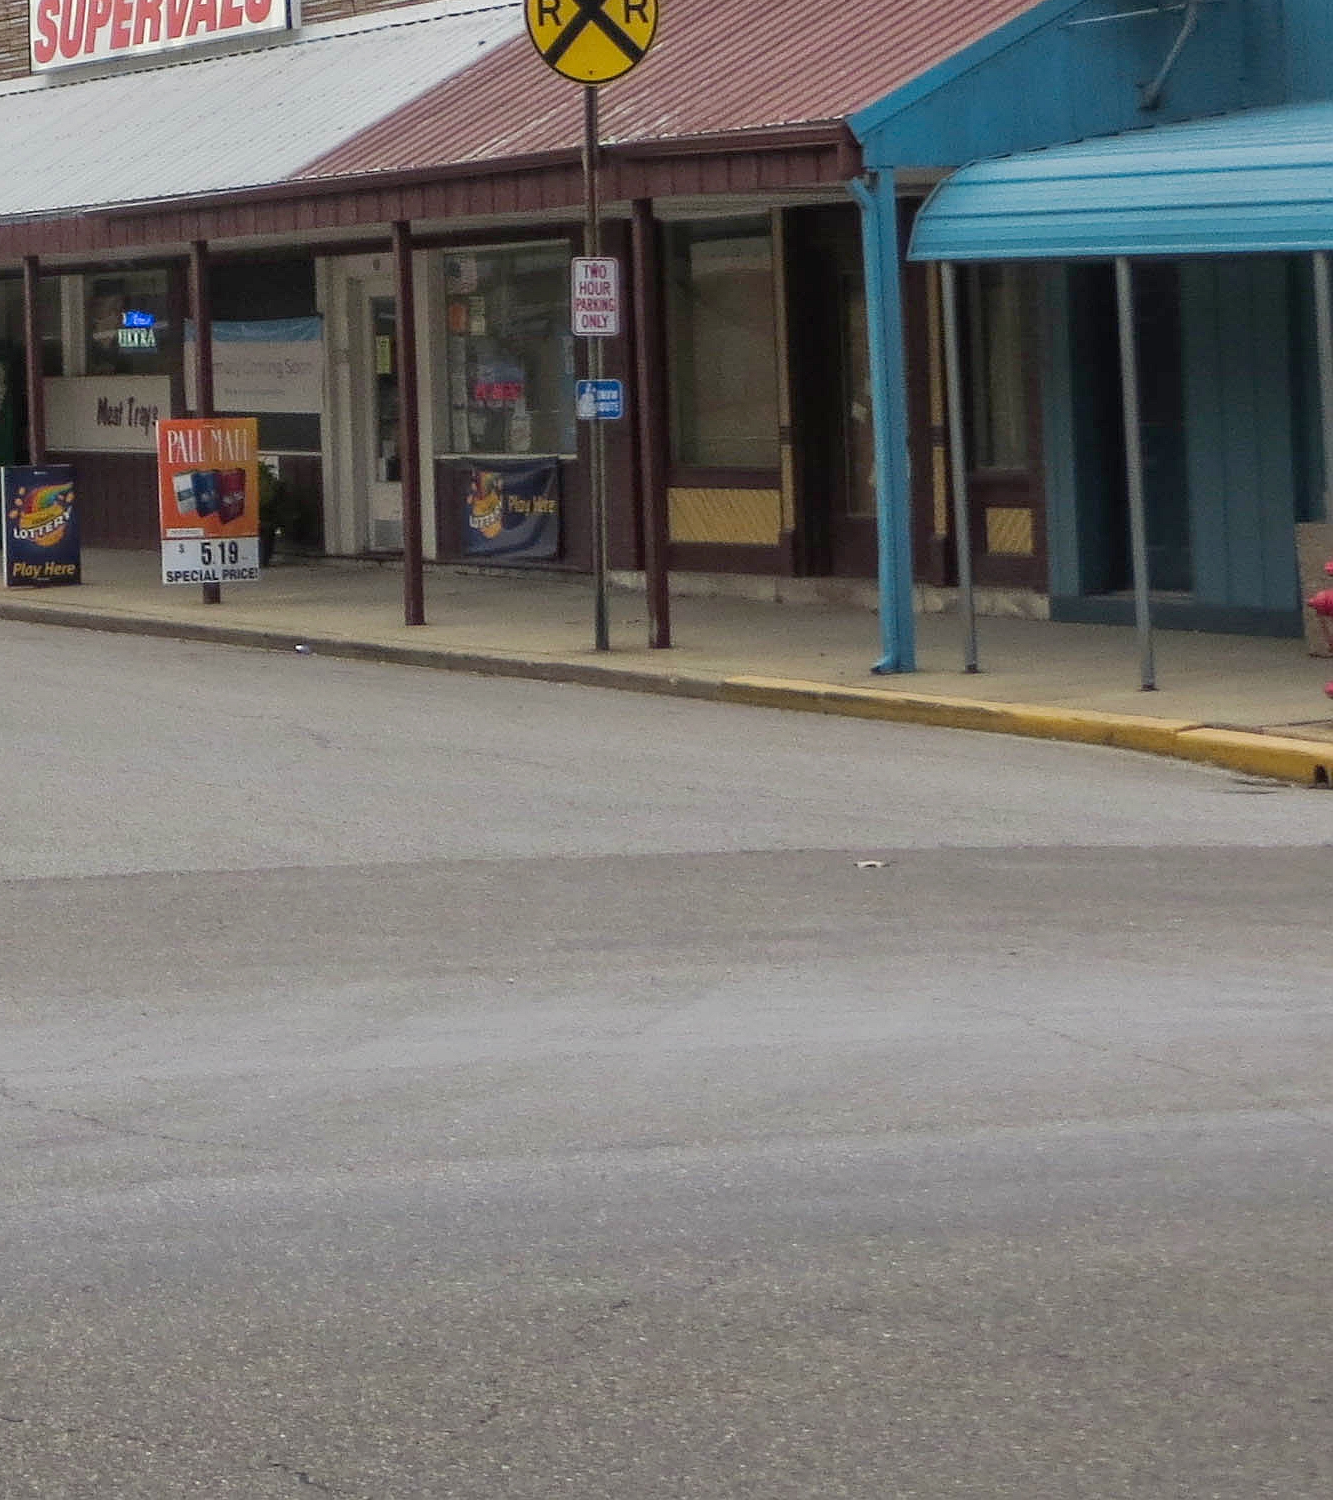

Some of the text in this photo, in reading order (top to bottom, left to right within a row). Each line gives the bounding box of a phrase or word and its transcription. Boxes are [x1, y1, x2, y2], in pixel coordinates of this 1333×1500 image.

[583, 264, 607, 279] TWO
[579, 281, 611, 296] HOUR
[574, 298, 616, 312] PARKING
[581, 314, 609, 328] ONLY
[167, 427, 252, 464] PALL MALL
[13, 506, 72, 539] LOTTERY
[200, 541, 239, 566] 5.19
[13, 561, 76, 578] Play Here
[166, 567, 258, 583] SPECIAL PRICE!
